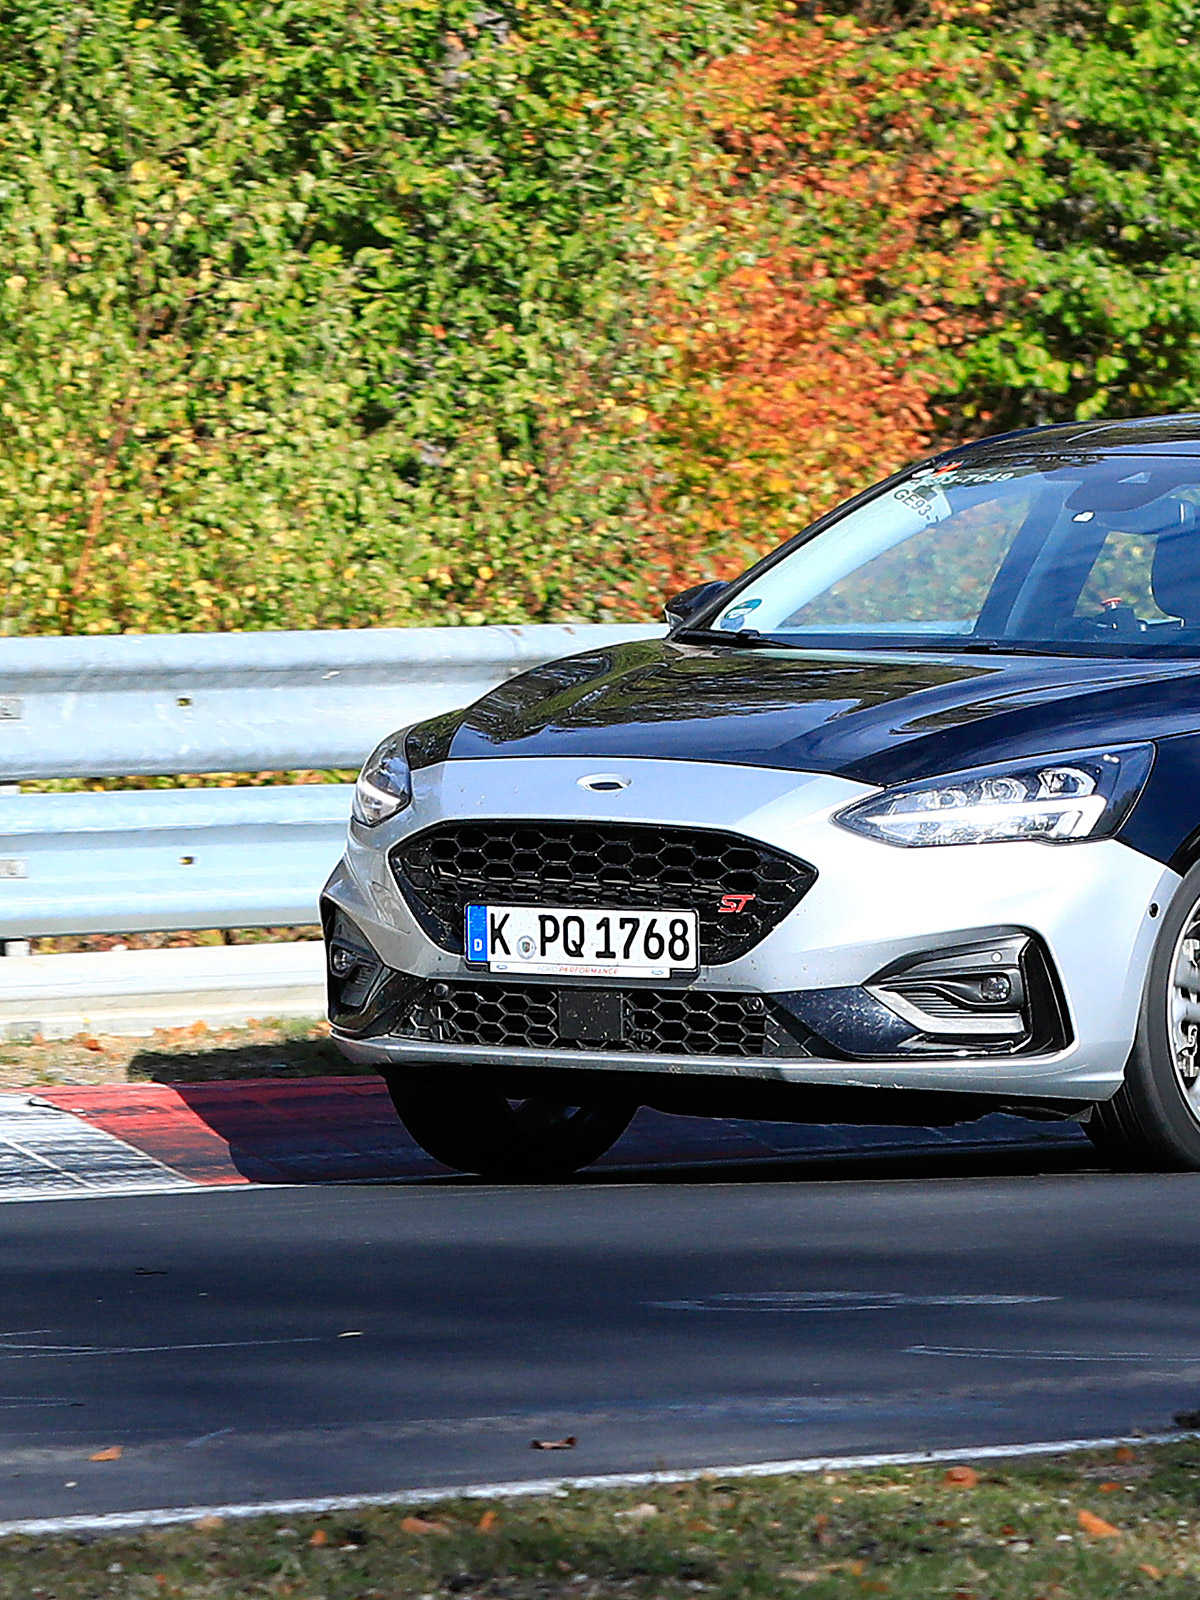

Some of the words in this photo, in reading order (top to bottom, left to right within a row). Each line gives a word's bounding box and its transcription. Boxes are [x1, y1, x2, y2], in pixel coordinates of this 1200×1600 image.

[718, 894, 756, 913] ST
[473, 938, 483, 951] D
[490, 912, 512, 956] K
[537, 914, 585, 958] PQ
[595, 917, 691, 962] 1768
[558, 965, 619, 975] PERFORMANCE
